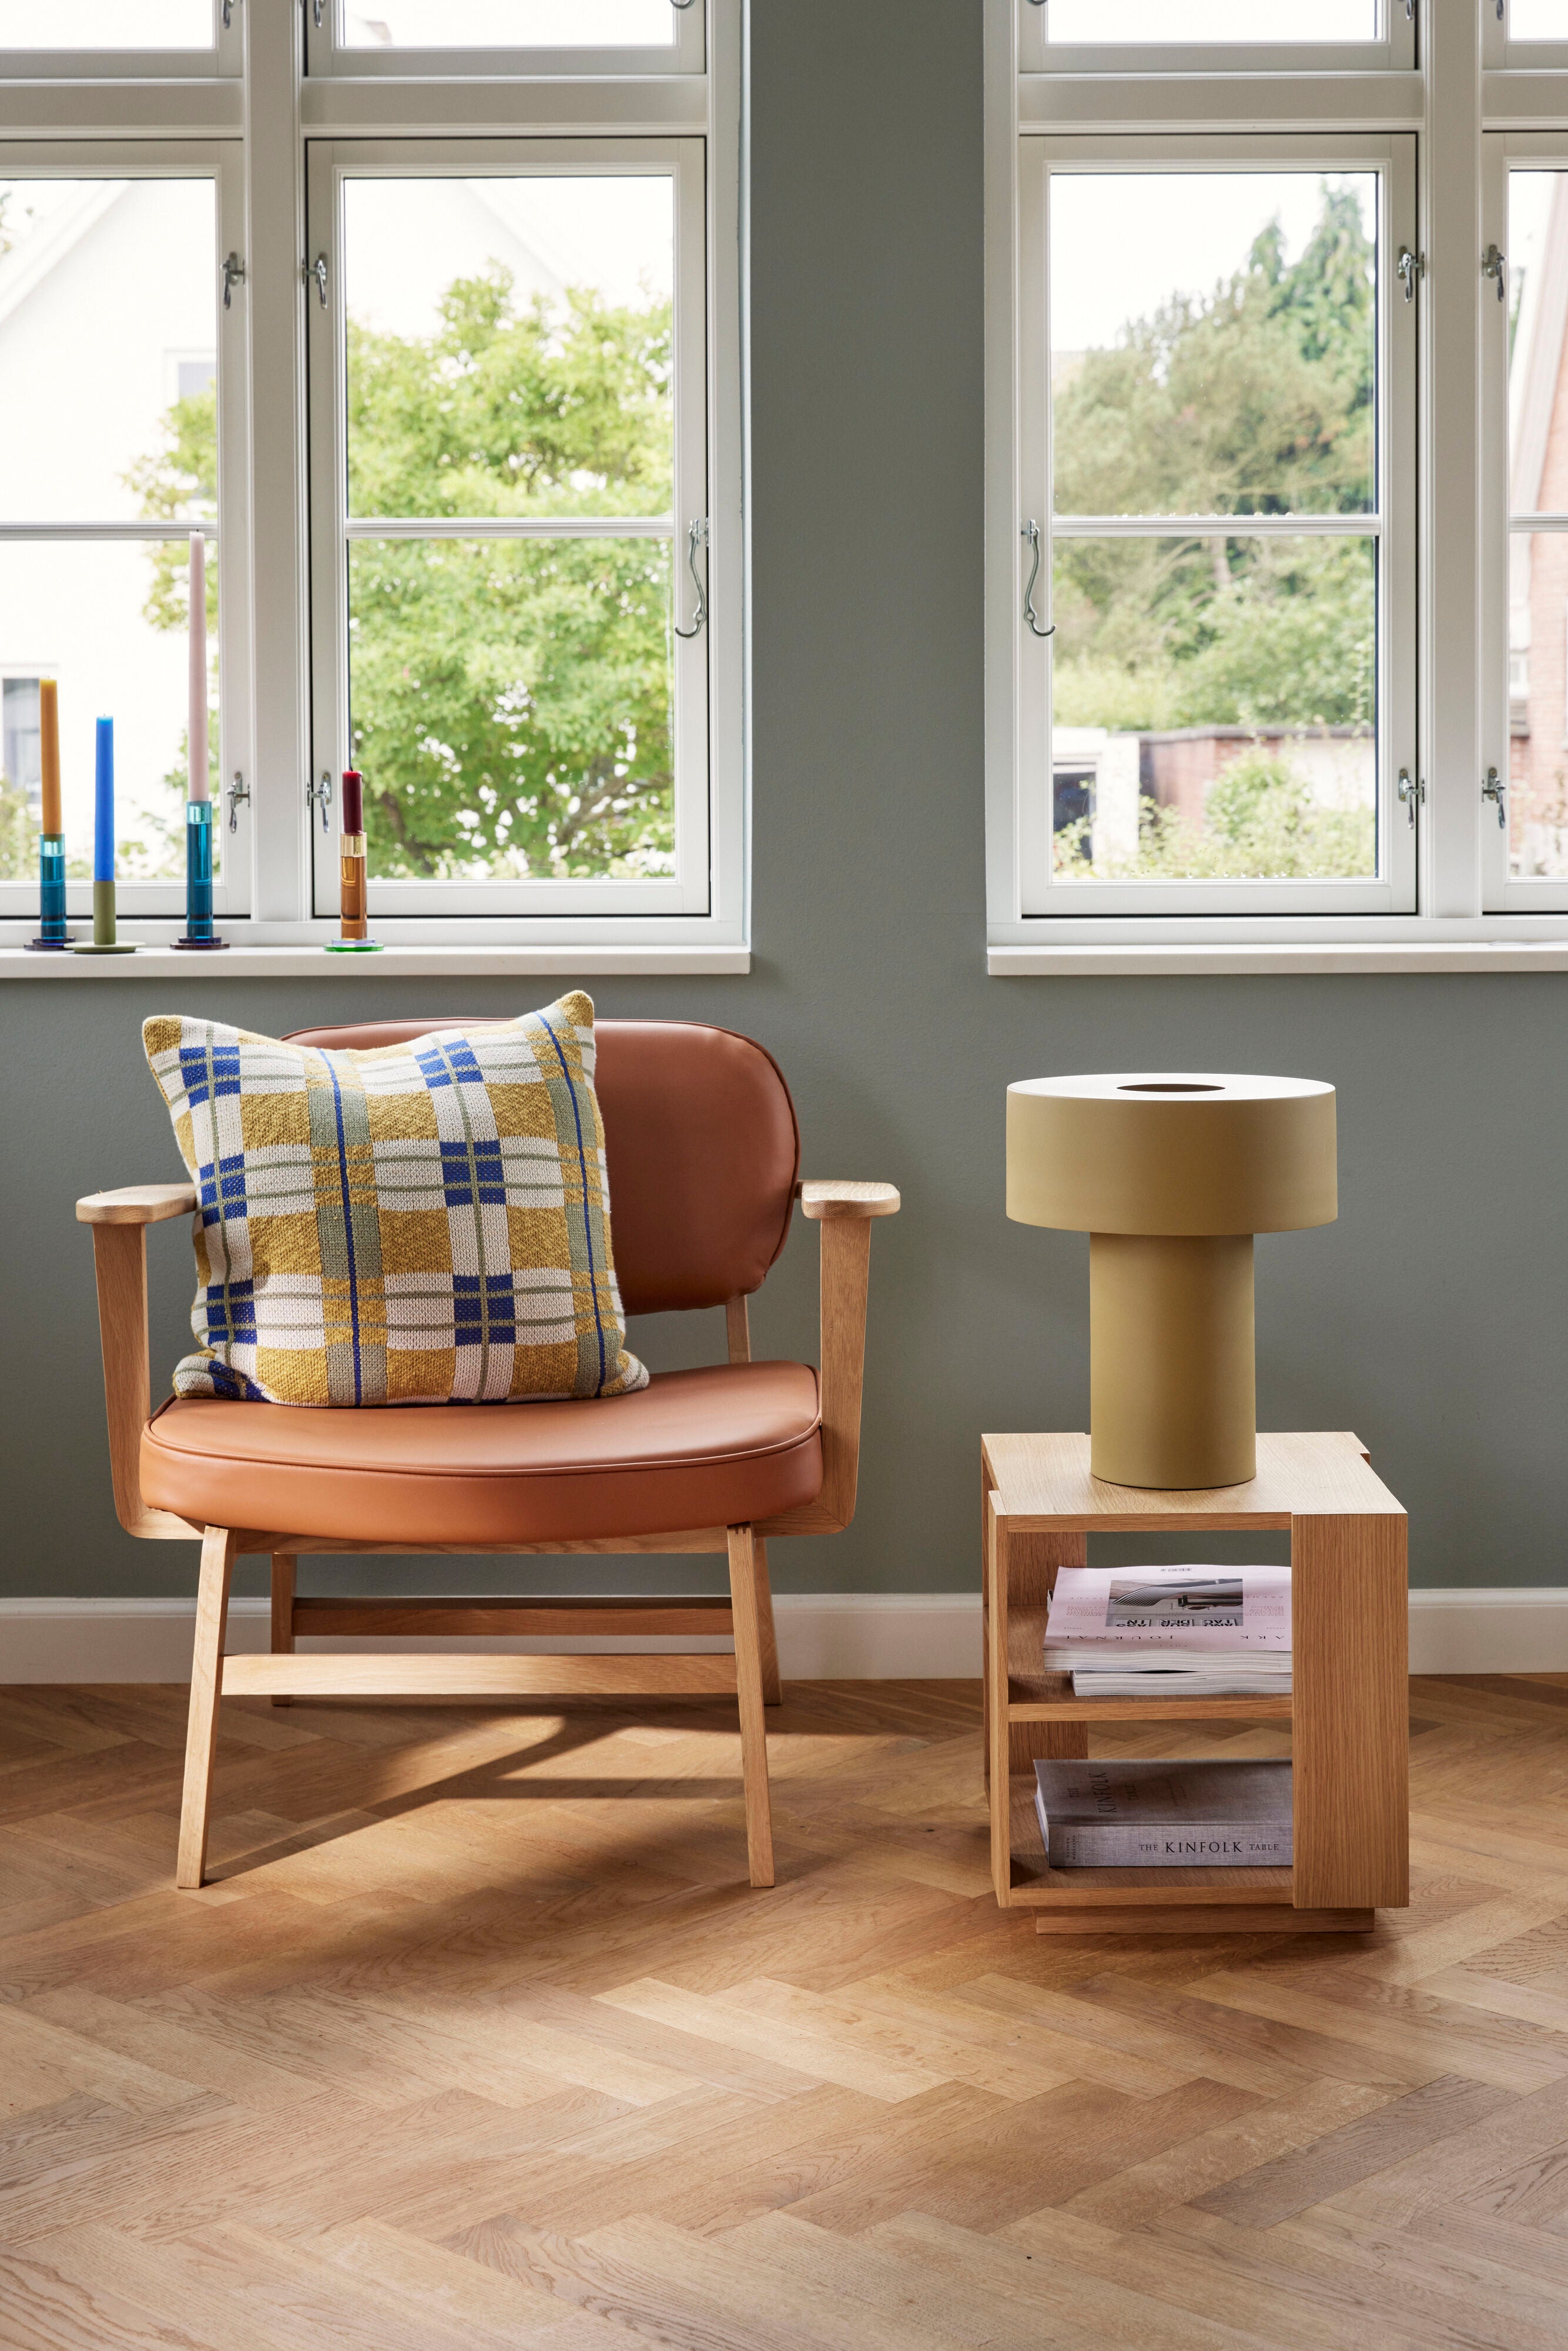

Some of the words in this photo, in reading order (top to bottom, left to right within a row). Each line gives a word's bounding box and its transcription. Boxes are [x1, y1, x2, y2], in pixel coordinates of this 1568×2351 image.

[1067, 1787, 1080, 1799] THE
[1088, 1771, 1117, 1813] KINFOLK
[1125, 1784, 1140, 1801] TABLE
[1165, 1841, 1243, 1853] KINFOLK
